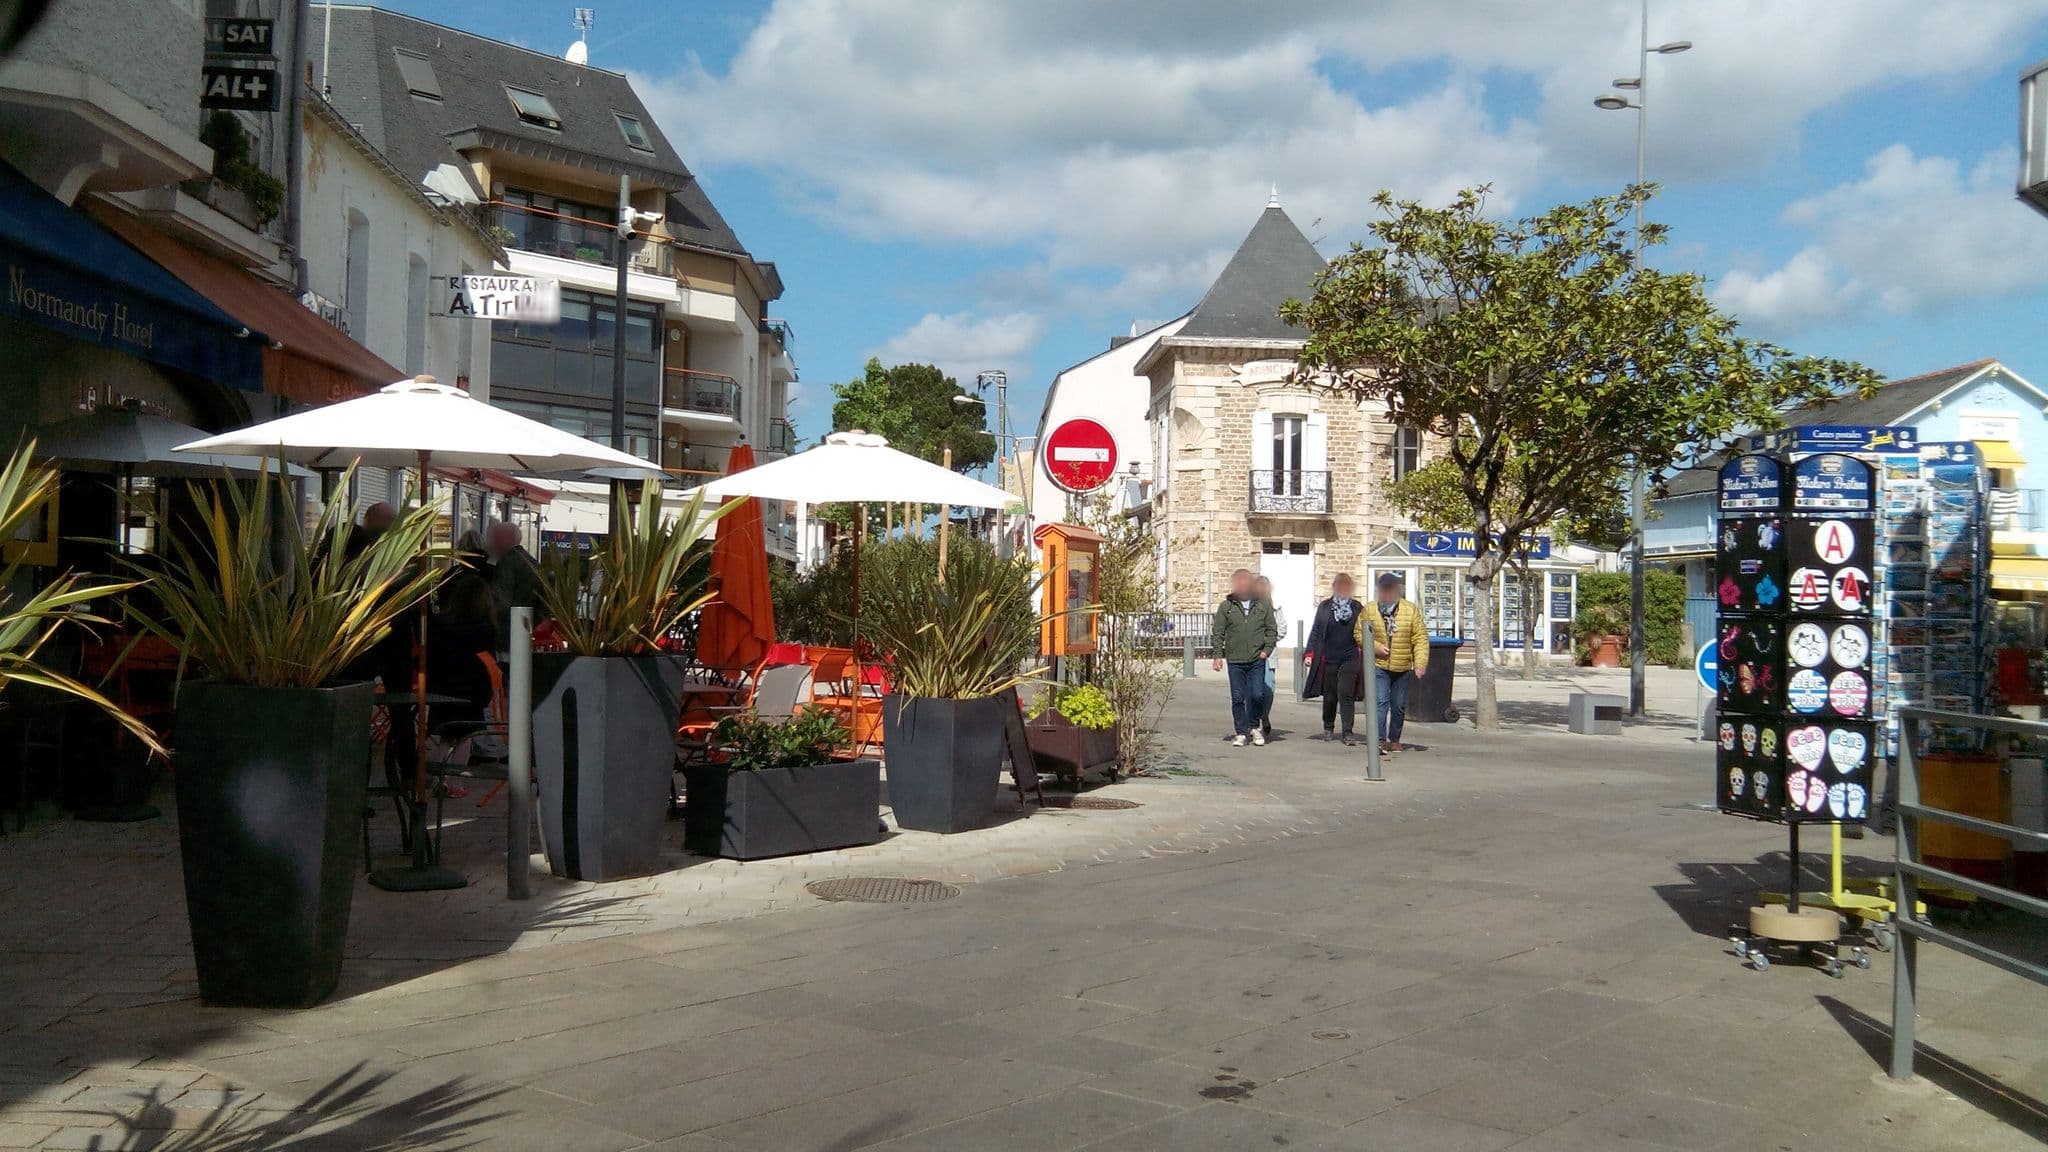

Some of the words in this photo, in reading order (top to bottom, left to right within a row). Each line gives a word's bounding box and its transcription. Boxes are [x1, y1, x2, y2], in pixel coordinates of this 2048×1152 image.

[9, 264, 108, 341] Normandy
[112, 302, 153, 349] Hotel
[1825, 525, 1845, 558] A
[1800, 573, 1819, 601] A
[1842, 572, 1861, 601] A
